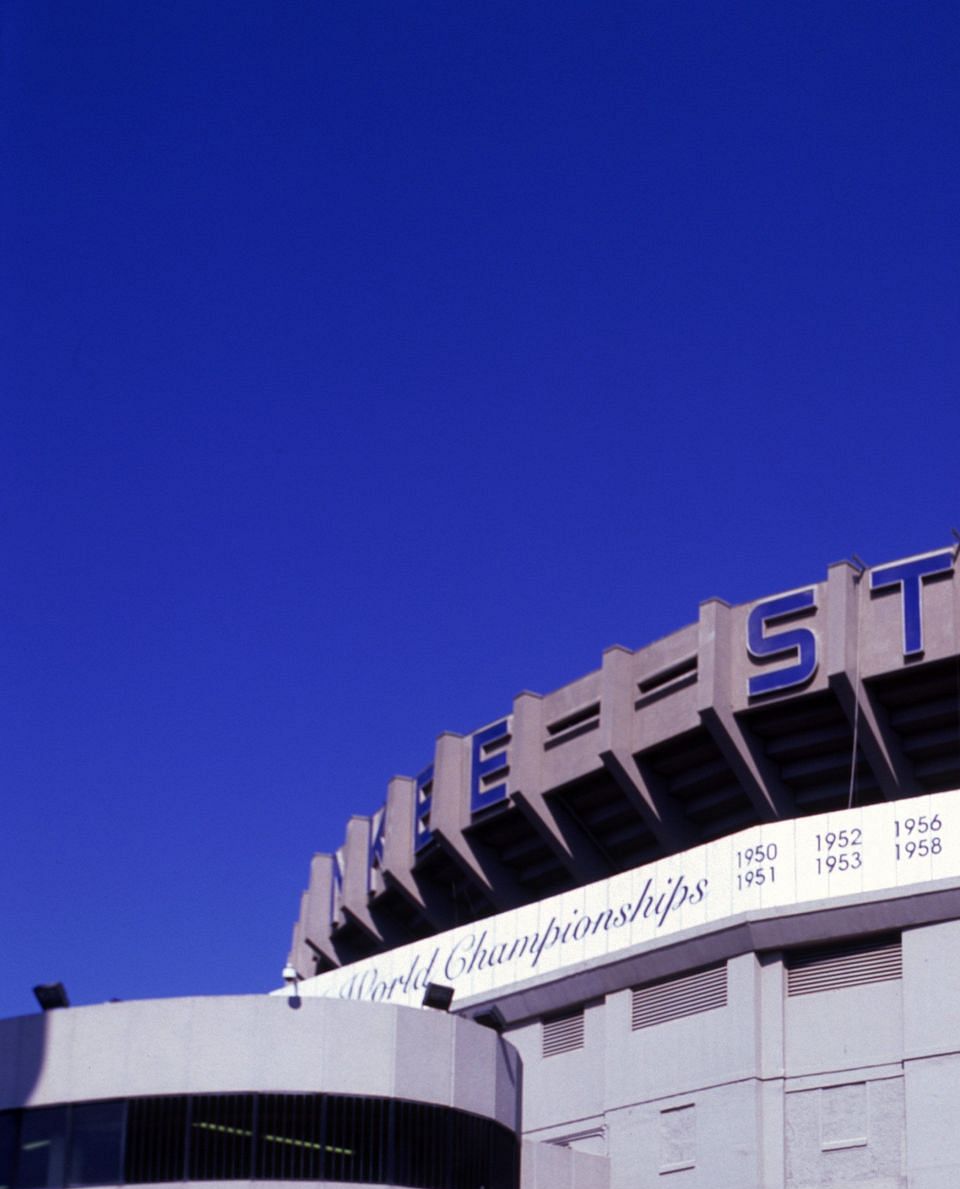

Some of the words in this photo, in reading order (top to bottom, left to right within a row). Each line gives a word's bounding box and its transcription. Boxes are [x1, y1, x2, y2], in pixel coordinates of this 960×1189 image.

[737, 842, 778, 869] 1950
[815, 828, 863, 852] 1952
[894, 813, 943, 838] 1956
[737, 866, 776, 890] 1951
[816, 851, 863, 875] 1953
[894, 836, 943, 861] 1958
[338, 946, 440, 1001] World
[444, 875, 709, 981] Championships
